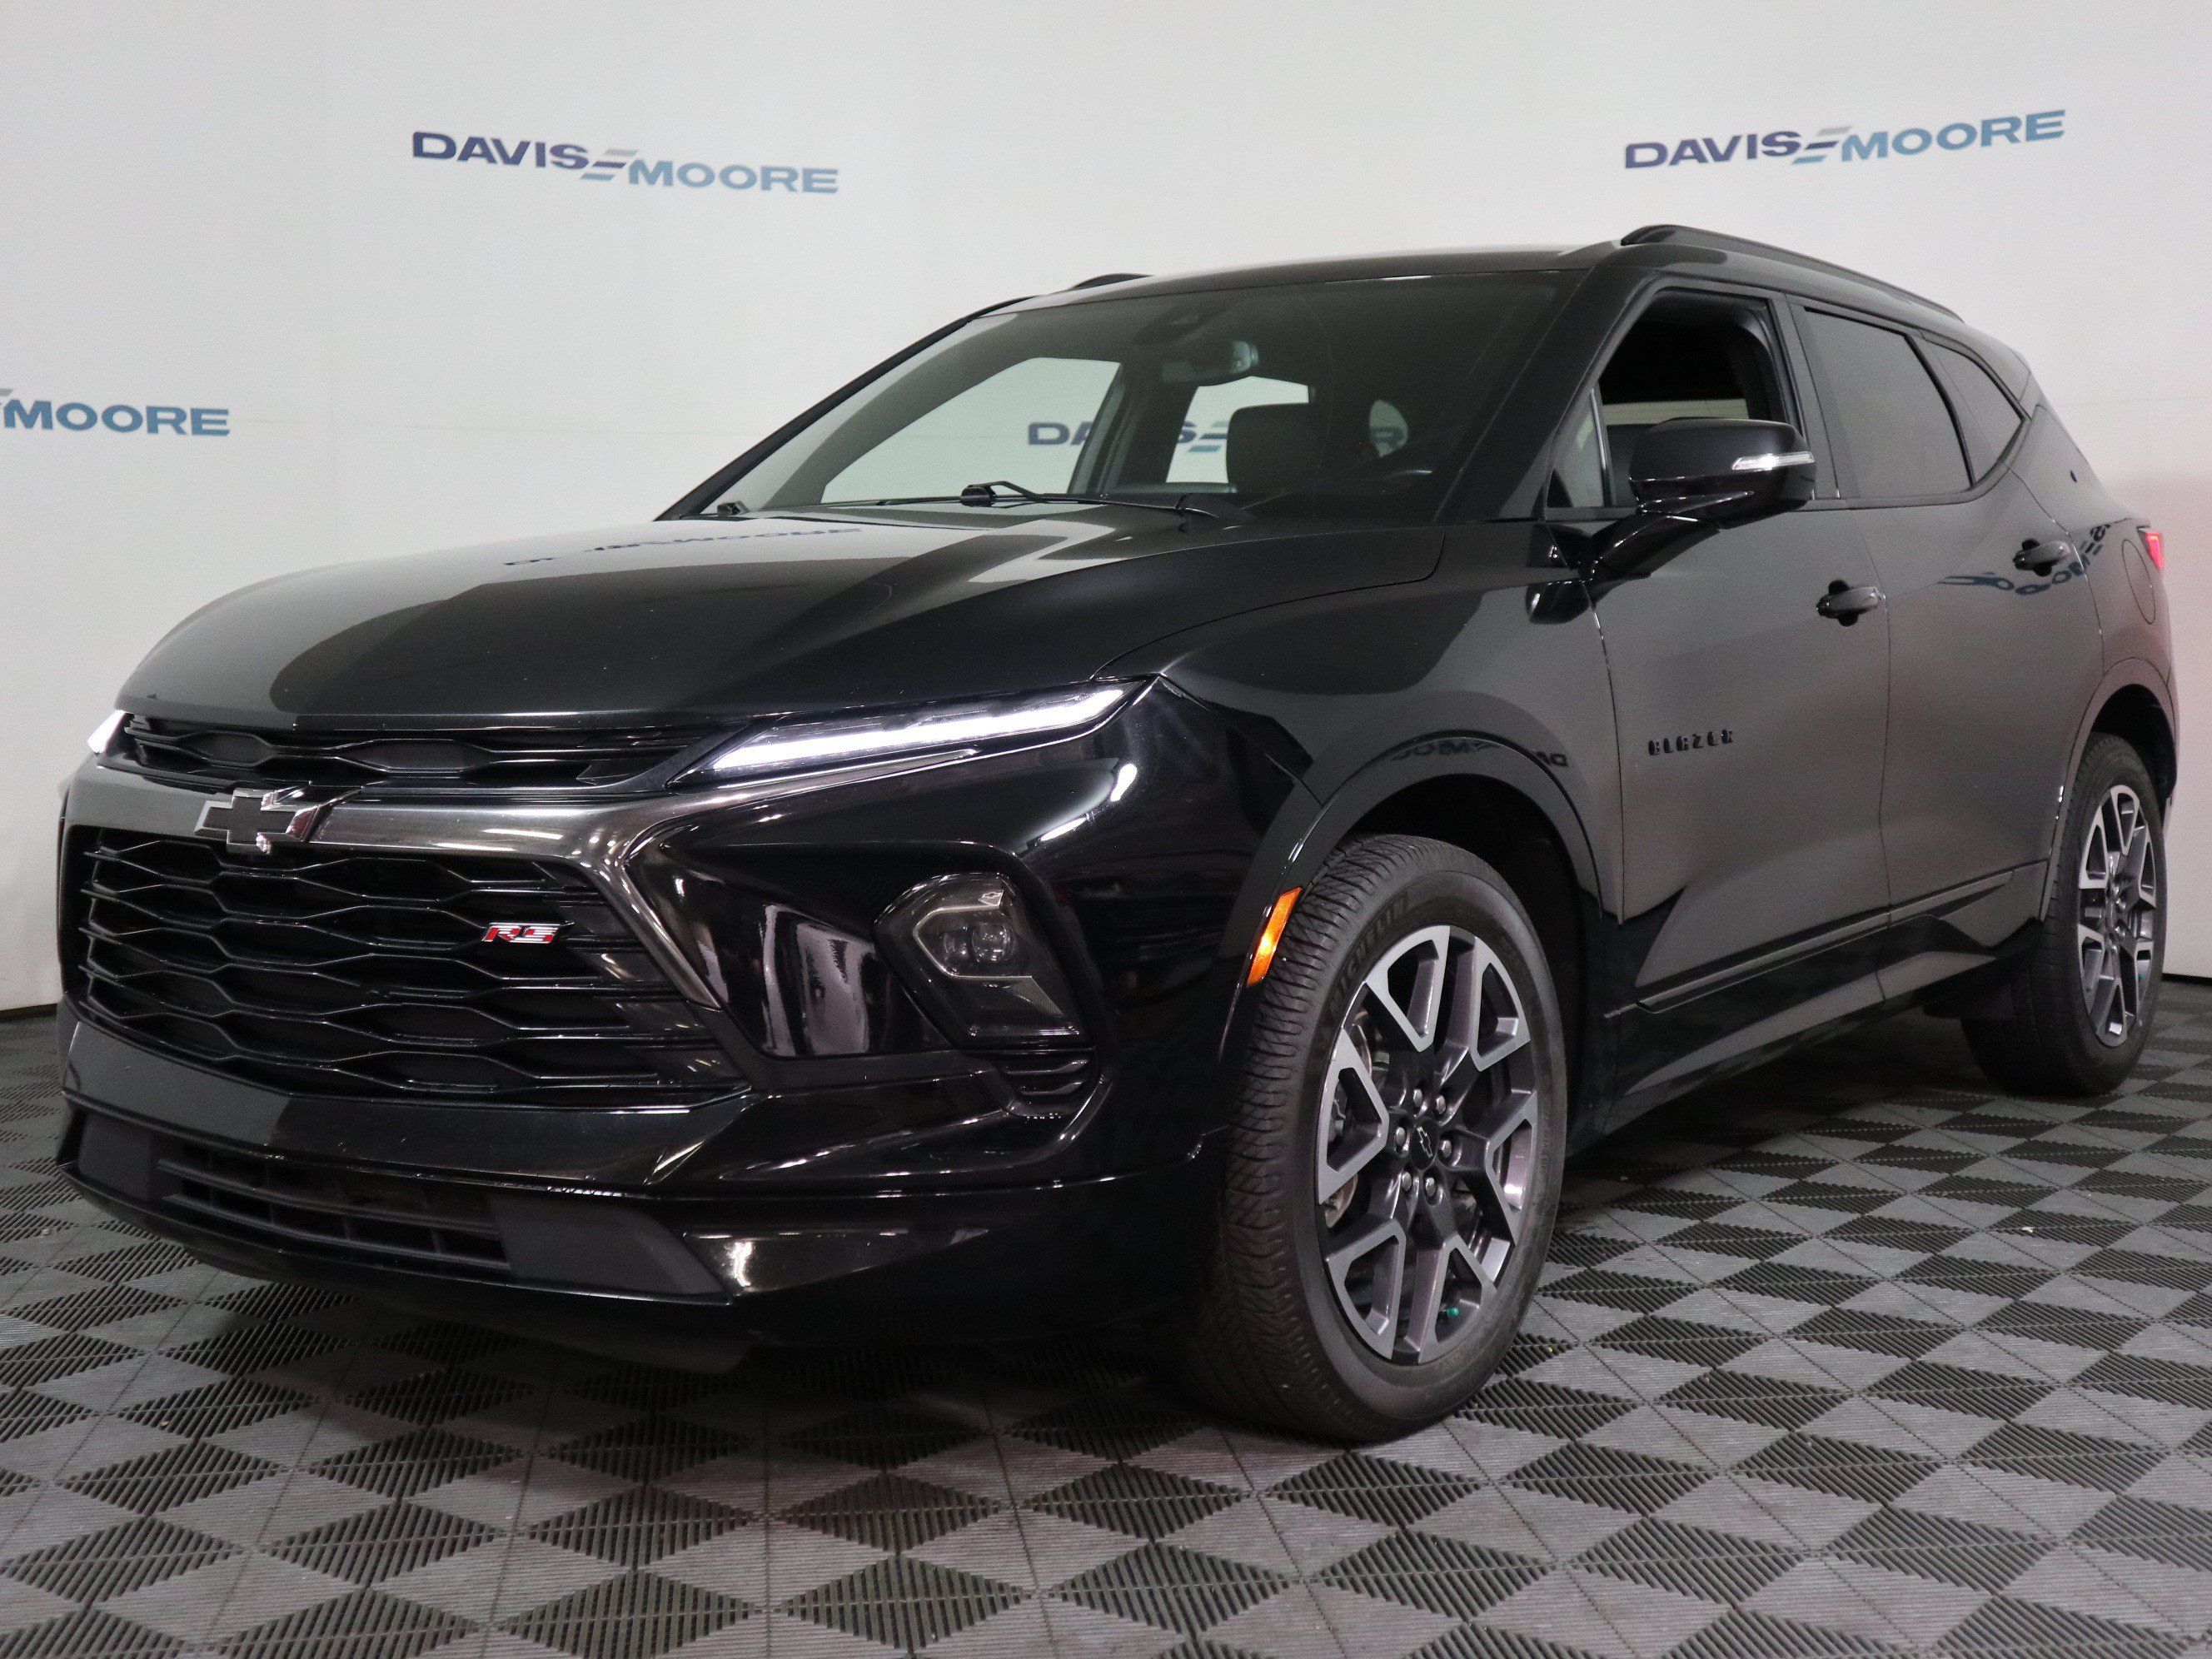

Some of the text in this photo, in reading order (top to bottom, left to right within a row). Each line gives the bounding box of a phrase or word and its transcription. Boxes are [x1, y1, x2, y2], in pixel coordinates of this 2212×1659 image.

[412, 131, 839, 195] DAVIS MOORE
[1625, 109, 2066, 169] DAVIS MOORE
[2, 398, 231, 437] MOORE
[481, 922, 560, 944] RS
[1329, 894, 1407, 1005] MICHELIN
